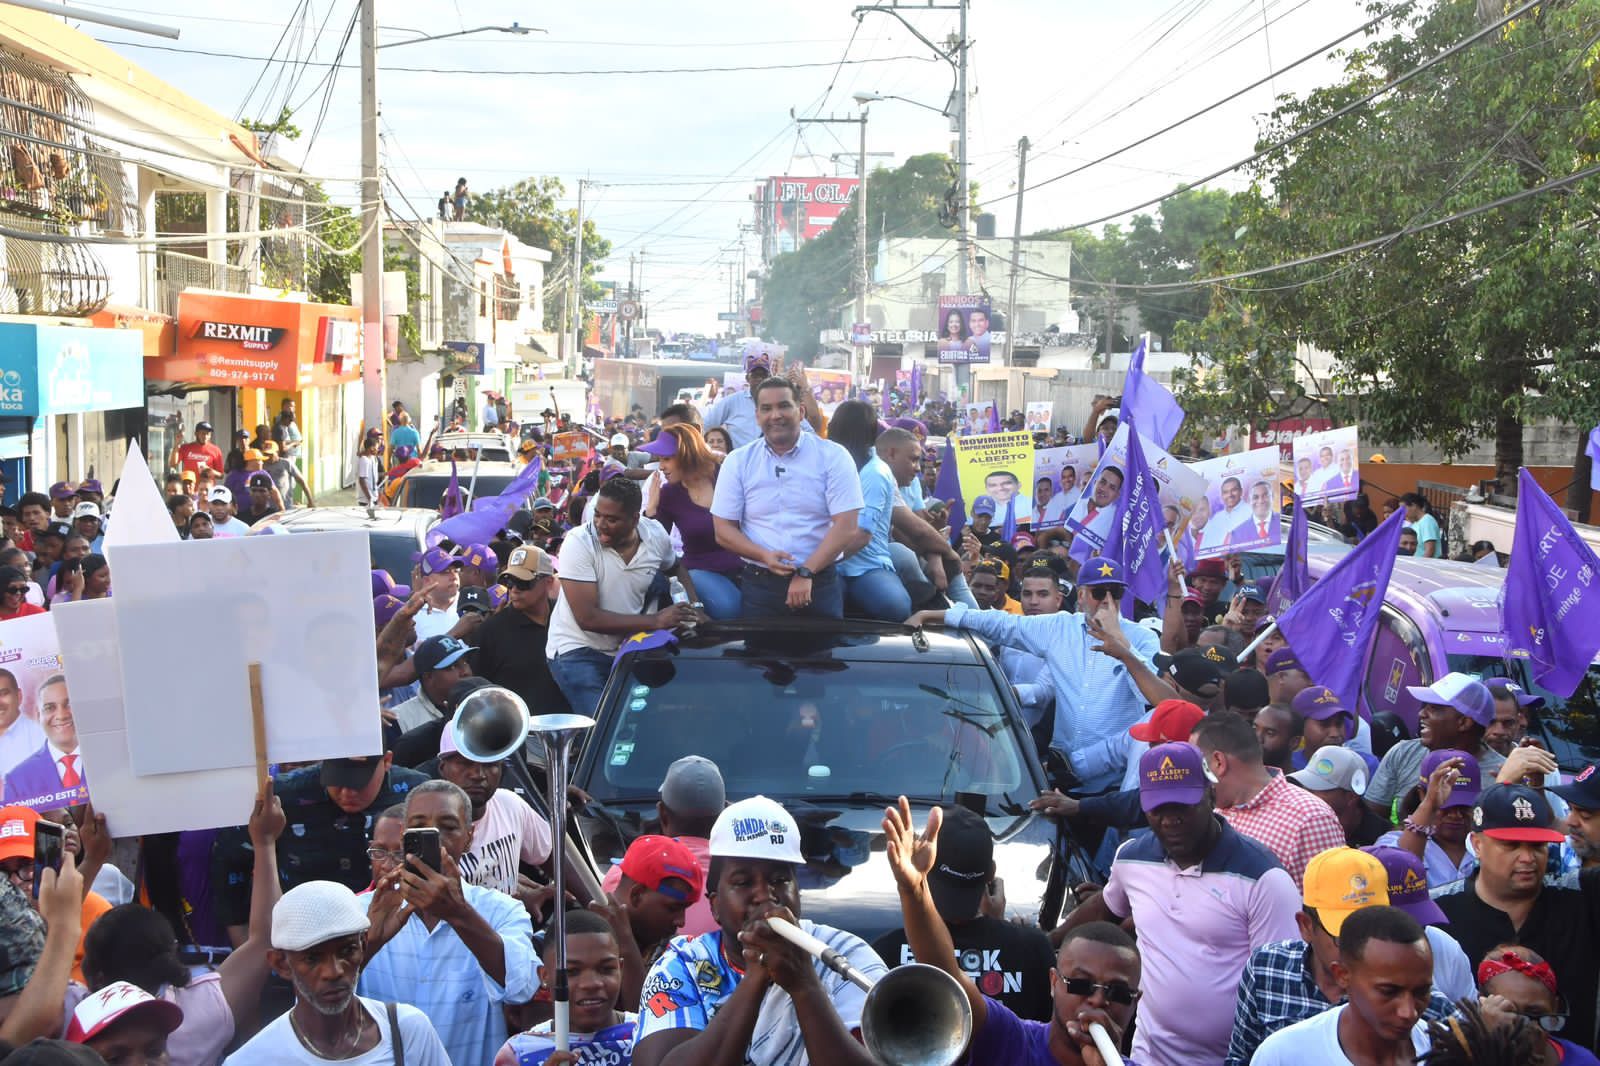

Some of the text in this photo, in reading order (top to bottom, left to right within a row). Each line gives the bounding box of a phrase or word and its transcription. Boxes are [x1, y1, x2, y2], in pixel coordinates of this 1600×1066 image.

[780, 182, 812, 201] EL
[204, 322, 272, 342] REXMIT
[243, 340, 269, 350] SUPPLY
[208, 355, 279, 370] @Rexmitsupply
[209, 368, 275, 381] 809-974-9174
[959, 434, 1029, 446] MOVIMIENTO
[960, 442, 1015, 451] EMPRENDEDORES
[969, 453, 1027, 464] ALBERTO
[1146, 768, 1190, 778] LUIS ALBERTO
[55, 788, 77, 800] ESTE
[734, 818, 765, 837] BANDA
[770, 834, 784, 845] RD
[647, 990, 679, 1018] R
